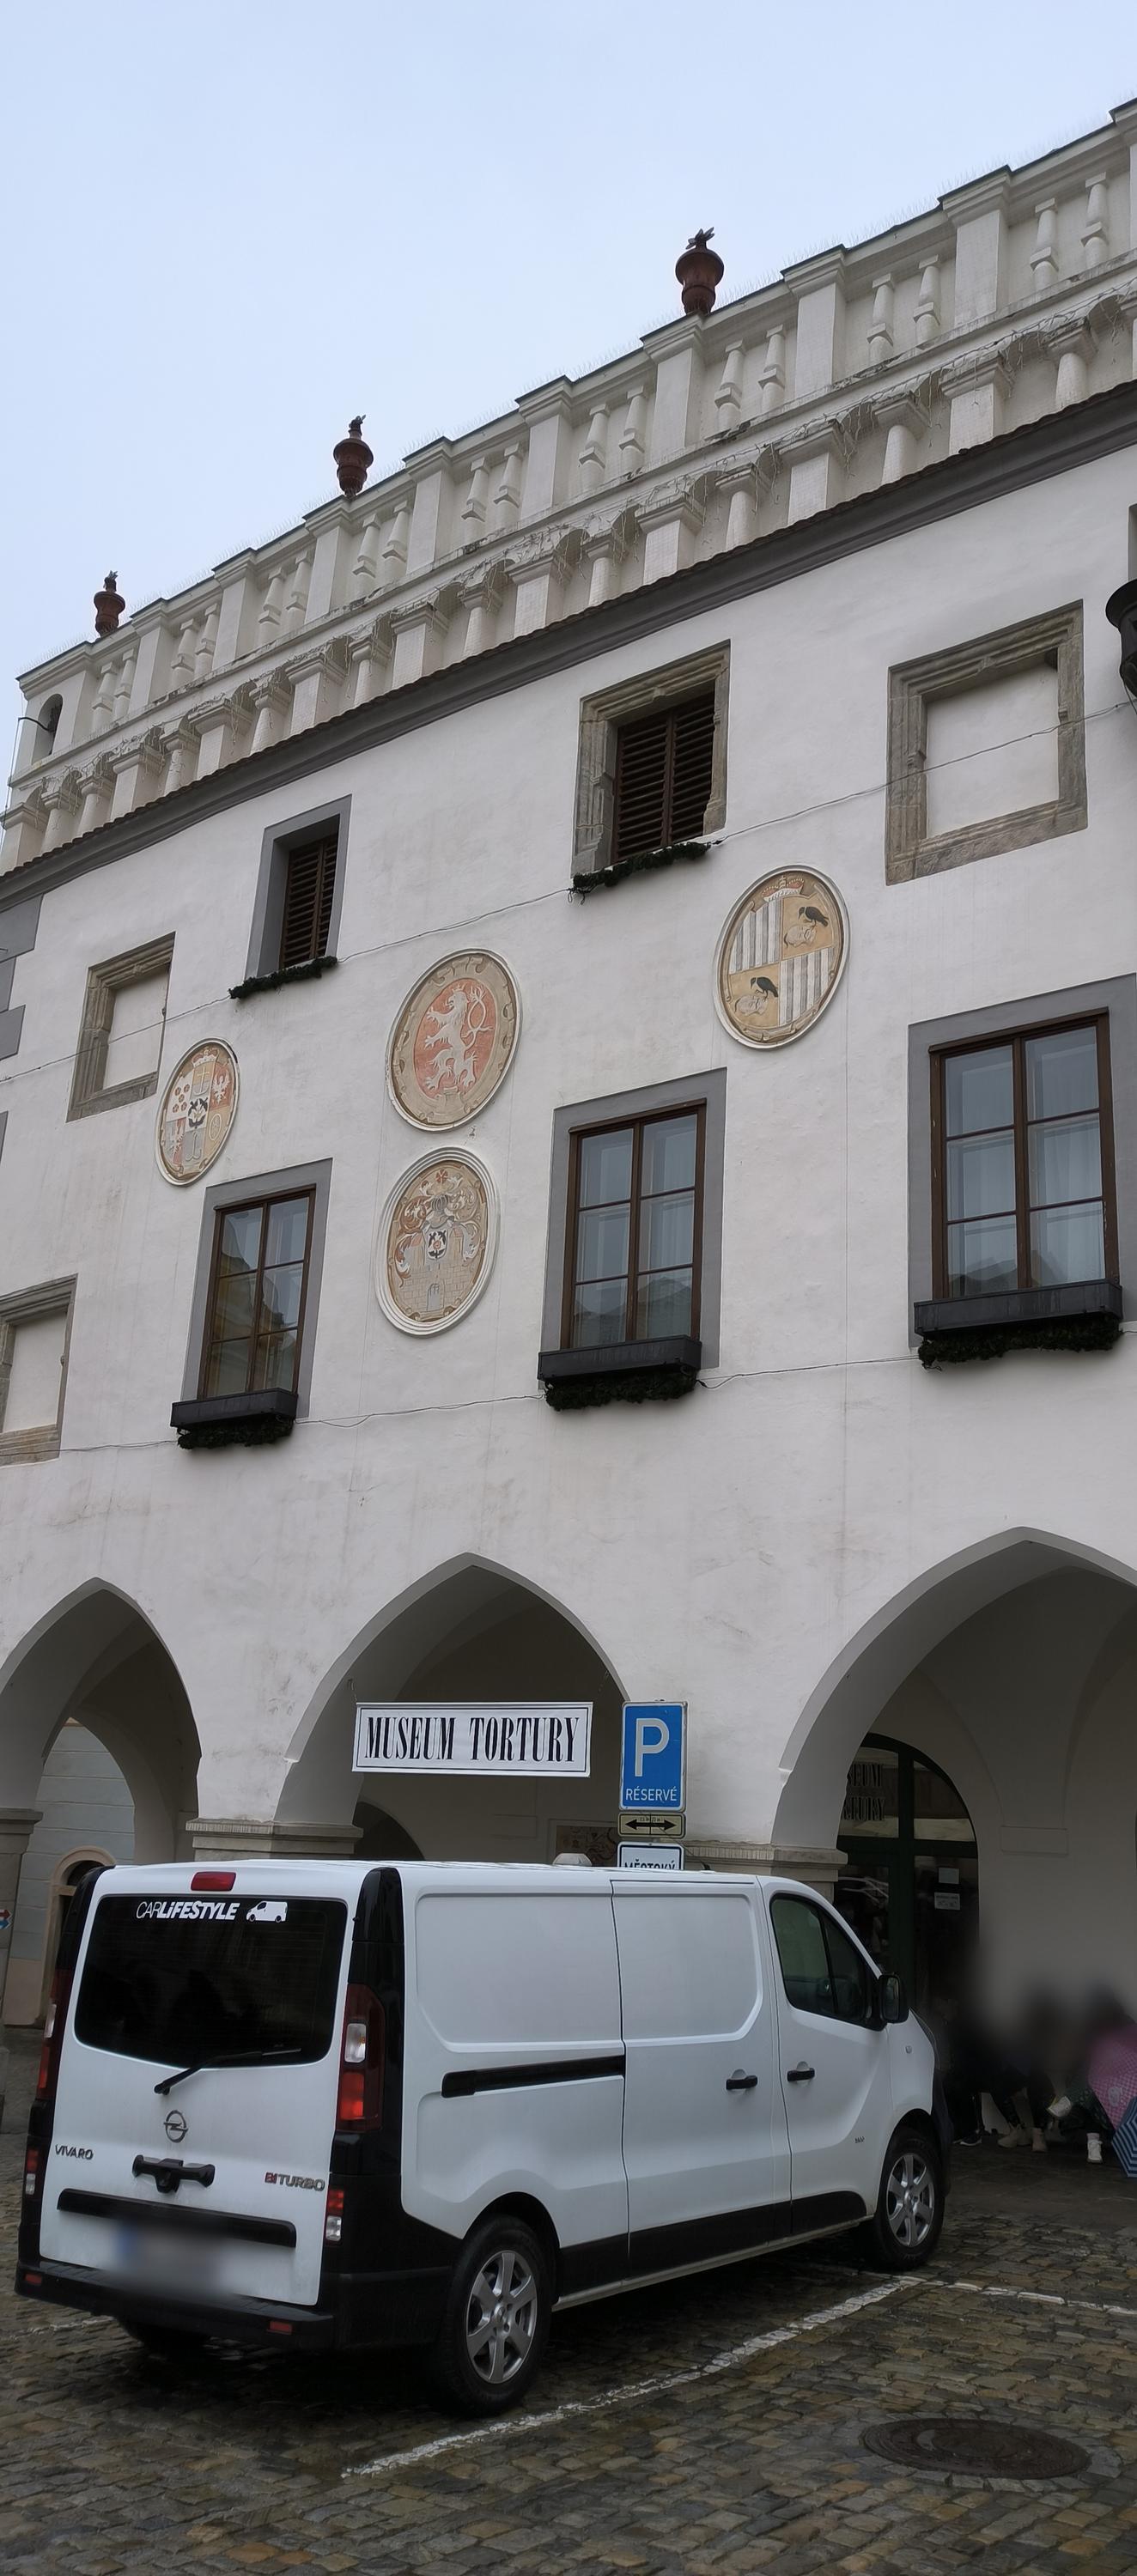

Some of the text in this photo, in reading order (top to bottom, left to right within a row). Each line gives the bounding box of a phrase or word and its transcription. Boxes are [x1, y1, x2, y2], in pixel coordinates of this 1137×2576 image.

[364, 1716, 580, 1763] MUSEUM TORTURY
[634, 1717, 670, 1777] P
[625, 1785, 678, 1802] RÉSERVÉ
[55, 2144, 94, 2160] VIVARO
